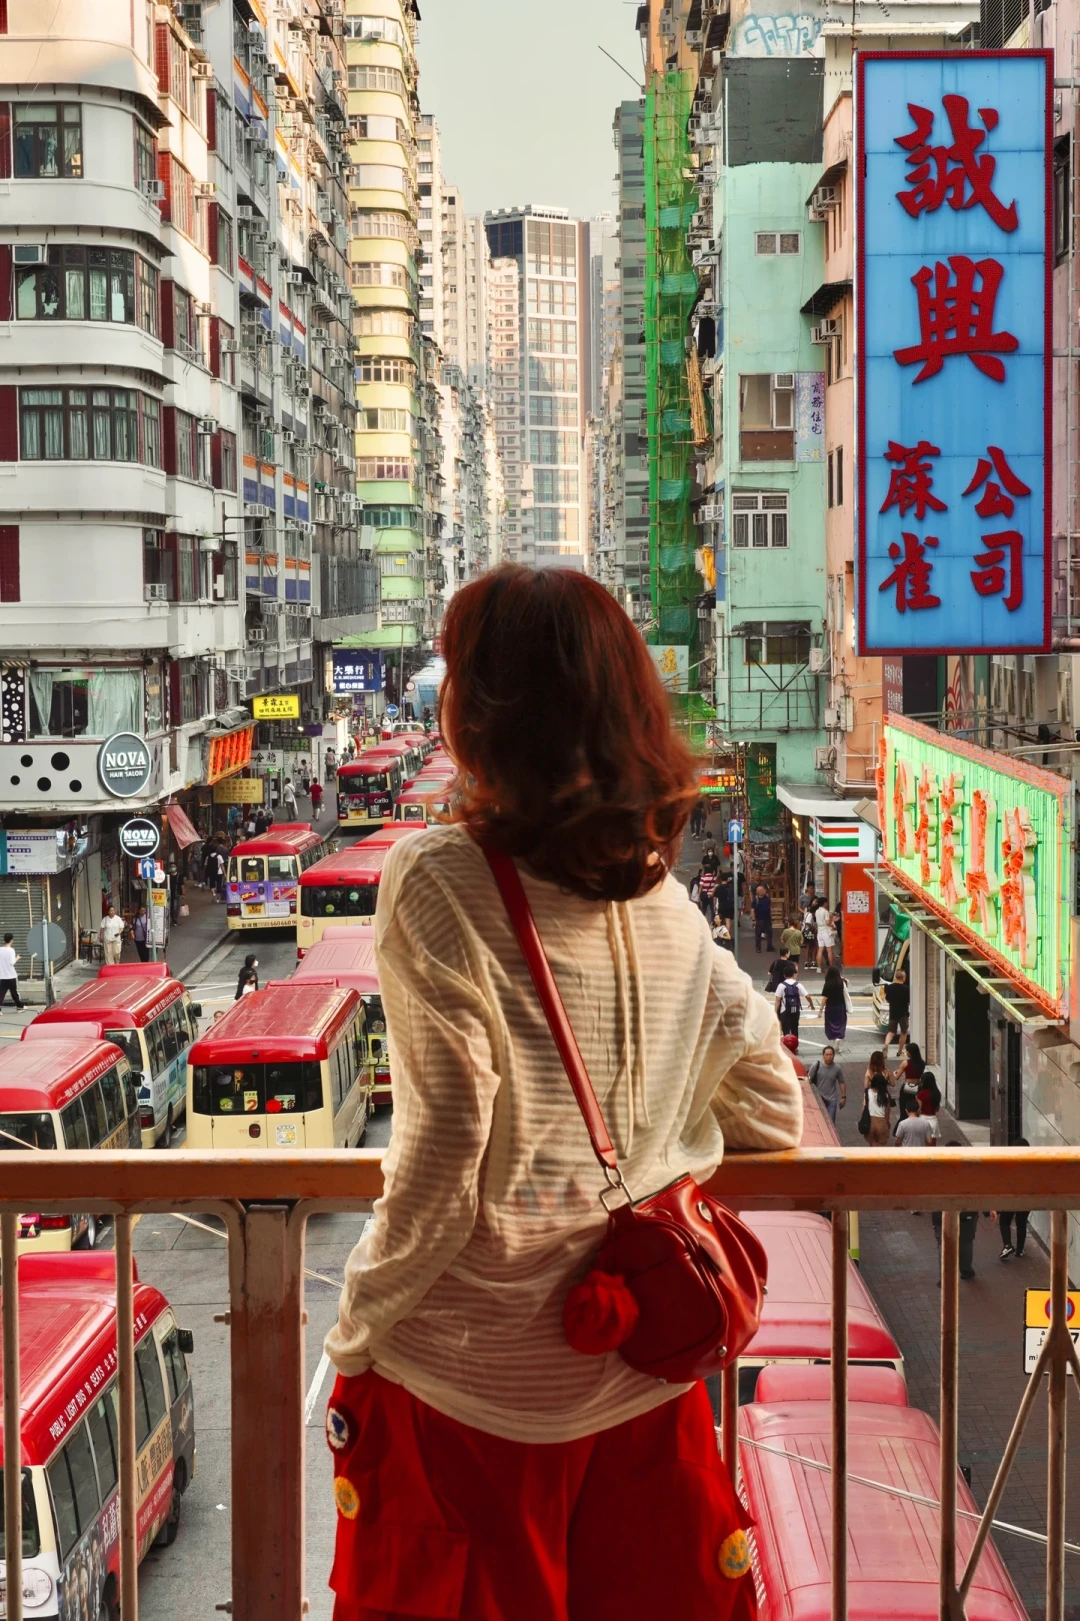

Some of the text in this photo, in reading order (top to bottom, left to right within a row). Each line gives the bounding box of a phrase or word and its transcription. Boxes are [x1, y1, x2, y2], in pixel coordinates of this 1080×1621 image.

[893, 94, 1019, 385] 誠興
[961, 446, 1031, 612] 公司
[105, 751, 146, 768] NOVA
[123, 830, 156, 840] NOVA
[49, 1415, 67, 1440] PUBLIC
[64, 1398, 79, 1421] LIGHT
[75, 1389, 87, 1407] BUS
[89, 1365, 105, 1387] SEATS
